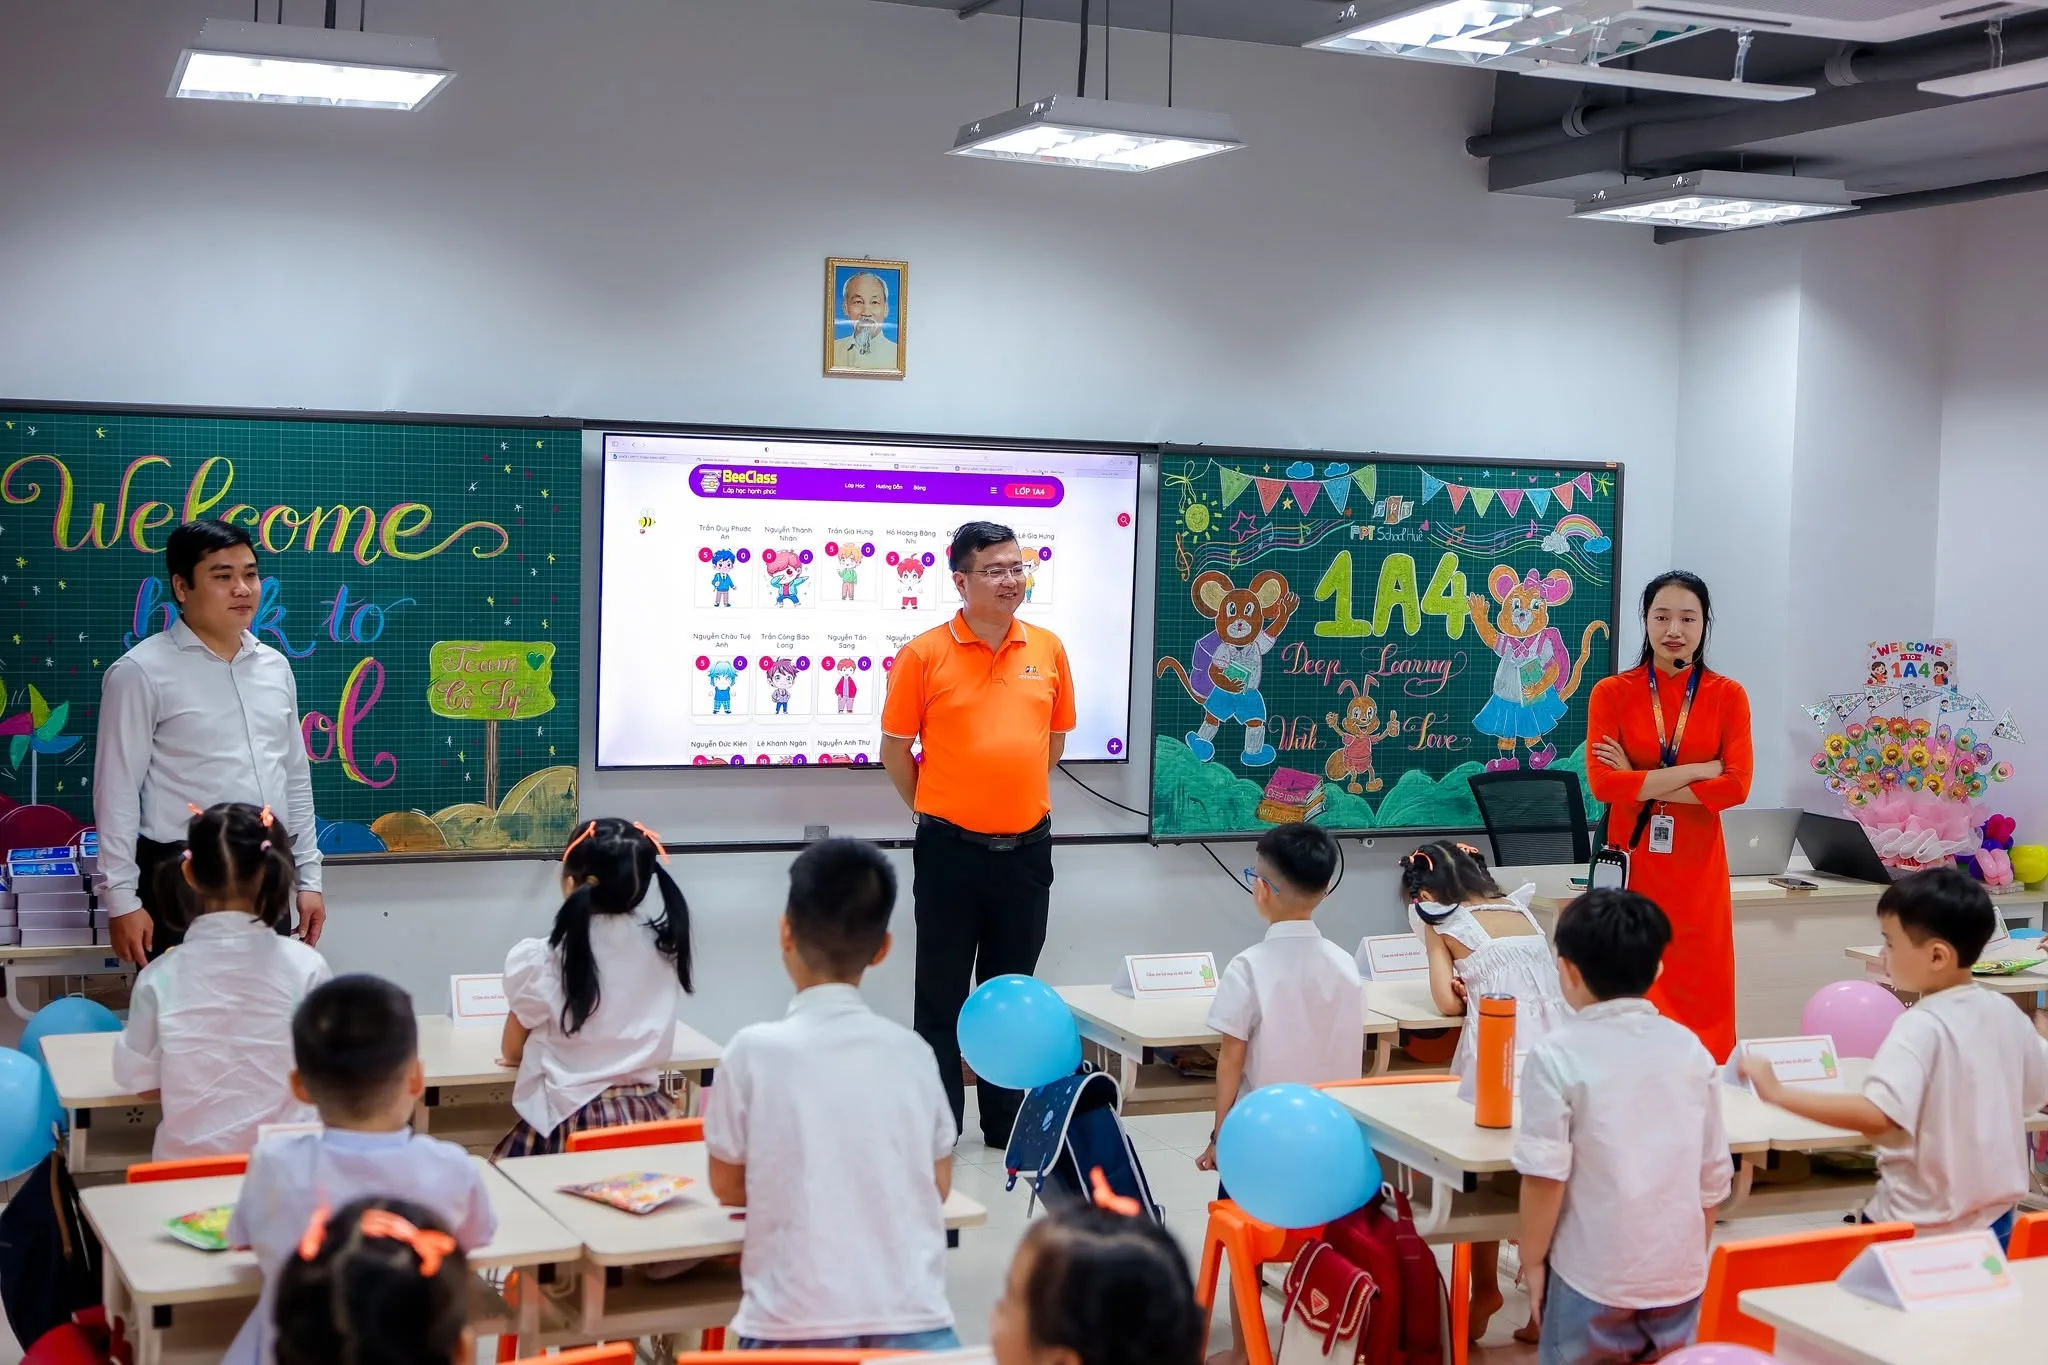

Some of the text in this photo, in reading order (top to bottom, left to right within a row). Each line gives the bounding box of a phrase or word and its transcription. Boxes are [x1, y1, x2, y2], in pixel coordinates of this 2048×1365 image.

[722, 469, 778, 485] BeeClass
[722, 487, 735, 495] Lớp
[735, 487, 746, 495] học
[762, 488, 777, 496] phúc
[1015, 485, 1045, 496] LỚP 1A4
[0, 454, 510, 567] Welcome
[715, 525, 730, 533] Duy
[764, 525, 790, 535] Nguyễn
[1350, 525, 1376, 541] FPT
[1376, 526, 1406, 542] School
[1314, 549, 1471, 640] 1A4
[320, 583, 416, 643] to
[693, 632, 720, 641] Nguyễn
[827, 633, 853, 642] Nguyễn
[776, 642, 794, 650] Long
[838, 643, 856, 651] Sang
[1876, 641, 1944, 657] WELCOME
[441, 642, 519, 673] Team
[1280, 641, 1348, 687] Deep
[1890, 661, 1931, 679] 1A4
[1268, 712, 1472, 752] With Love
[690, 740, 717, 749] Nguyễn
[817, 739, 841, 748] Nguyễn
